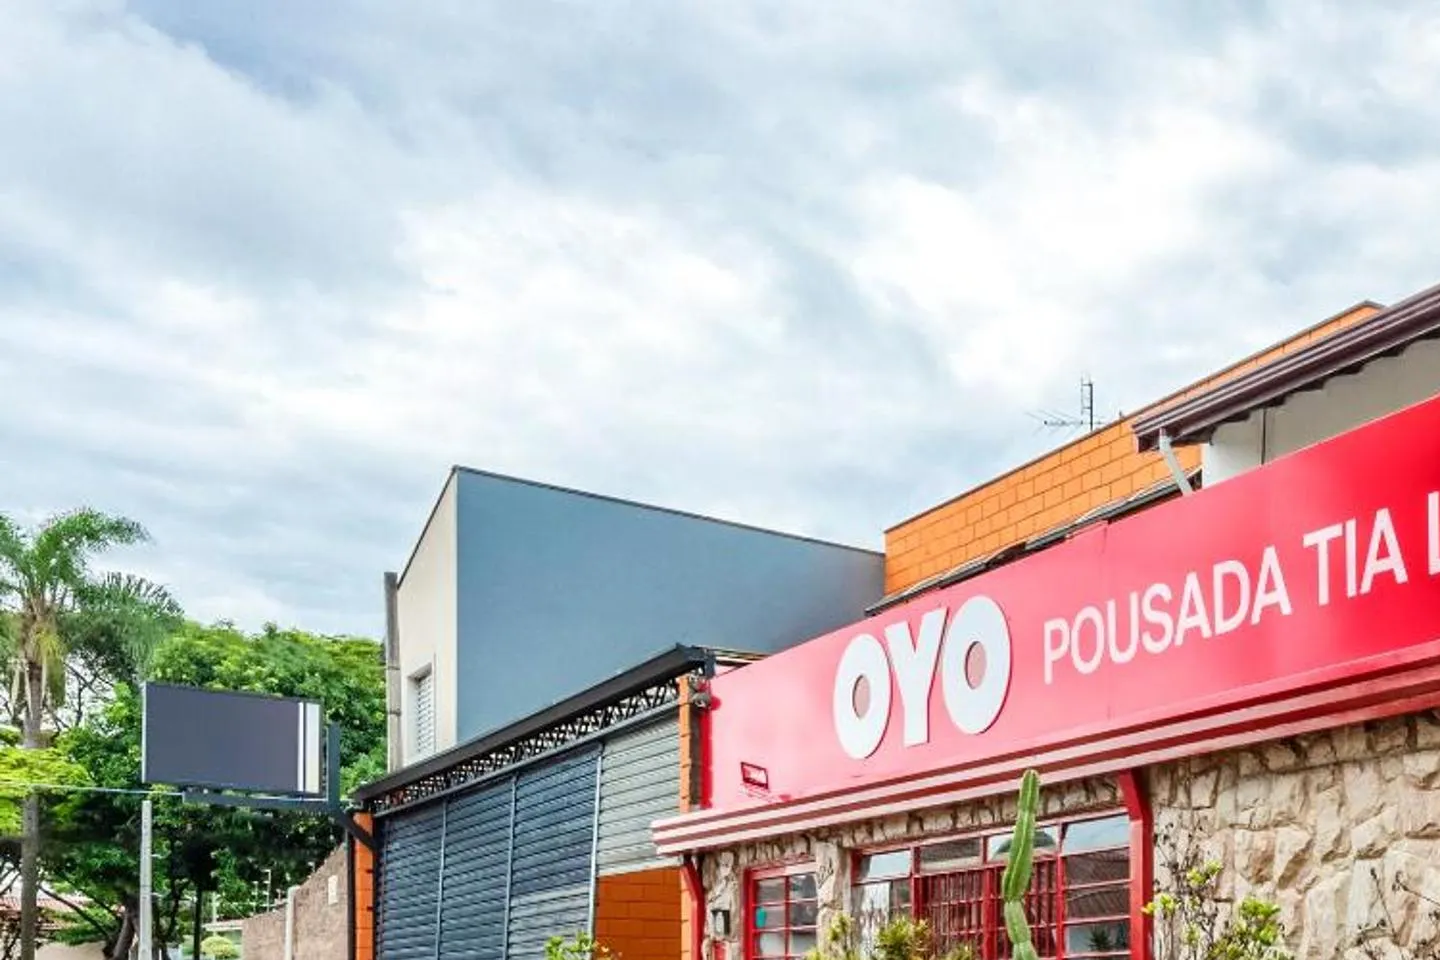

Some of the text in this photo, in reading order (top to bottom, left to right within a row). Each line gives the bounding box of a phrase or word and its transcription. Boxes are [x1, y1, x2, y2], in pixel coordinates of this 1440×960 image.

[833, 594, 1013, 760] OYO
[1043, 545, 1292, 685] POUSADA
[1303, 507, 1408, 606] TIA
